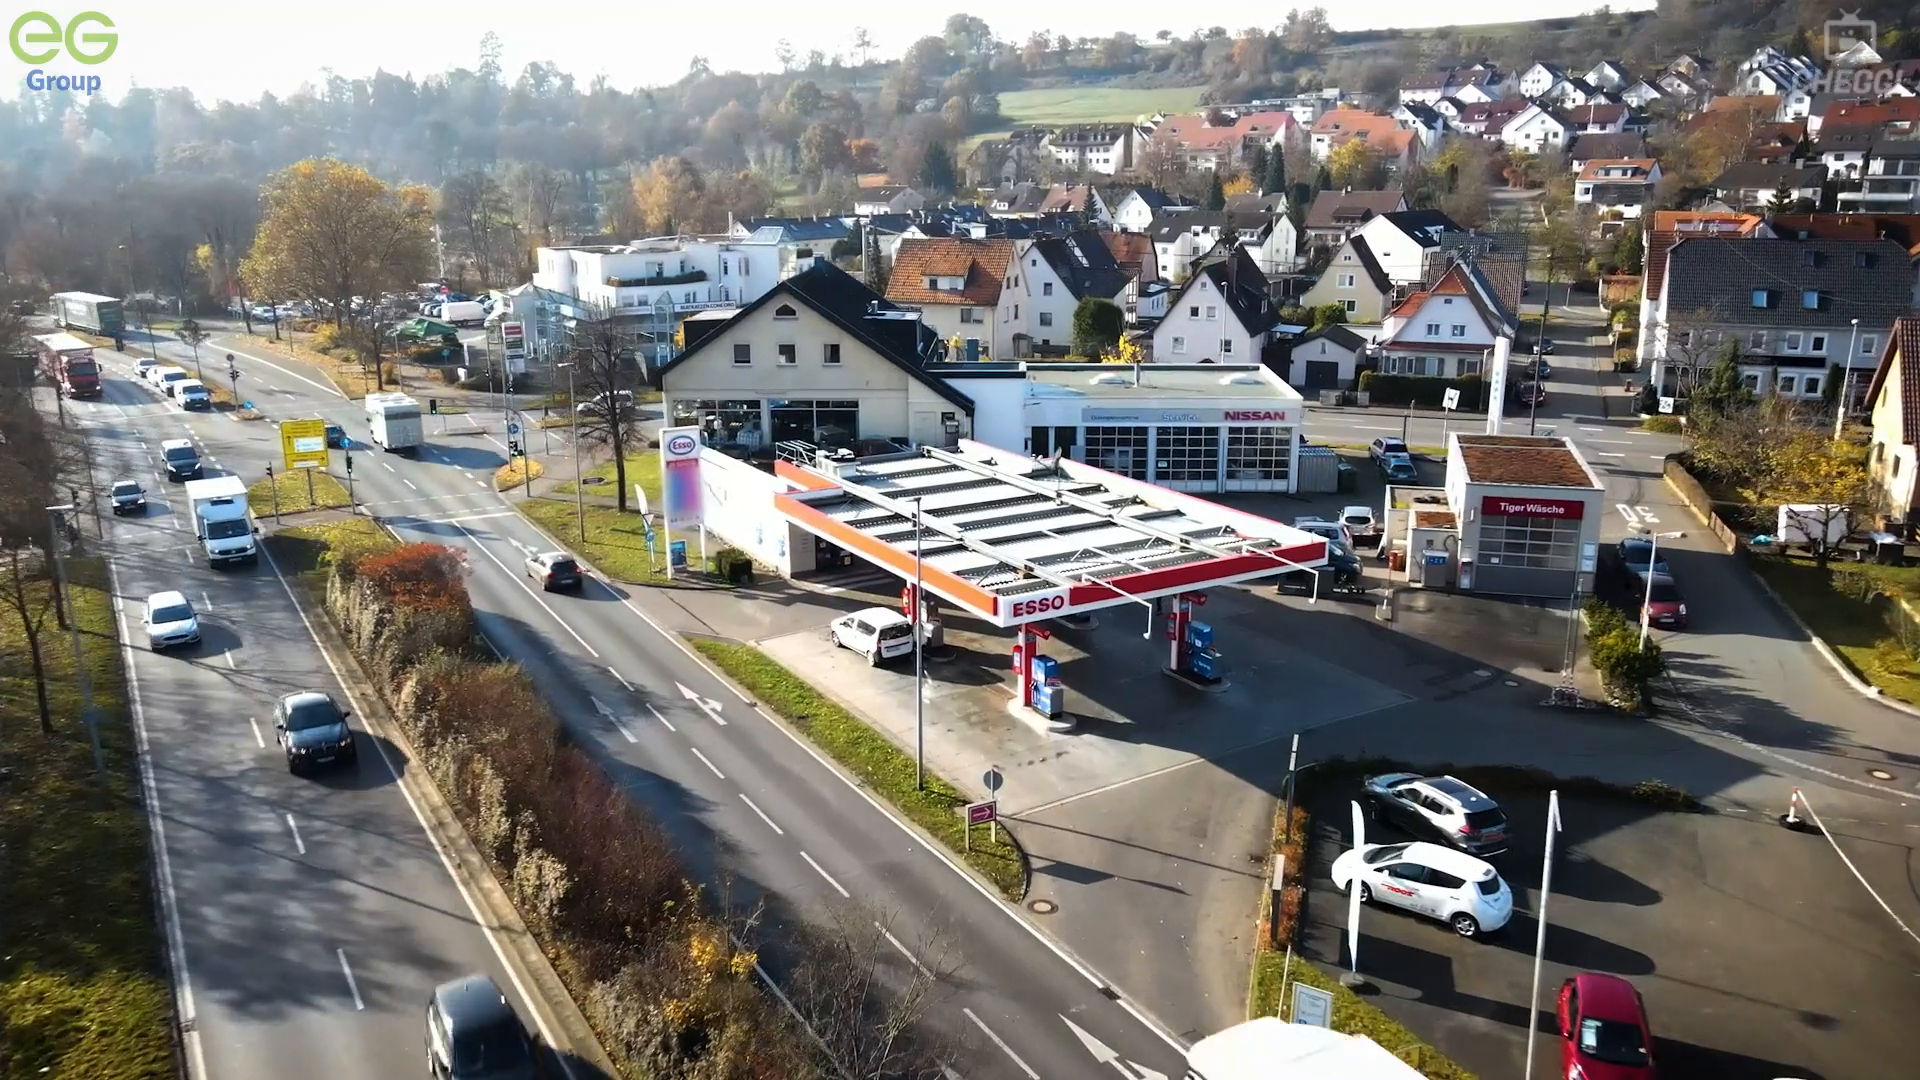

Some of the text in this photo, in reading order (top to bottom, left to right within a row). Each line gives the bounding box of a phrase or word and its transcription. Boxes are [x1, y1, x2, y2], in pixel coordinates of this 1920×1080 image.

[1224, 411, 1286, 420] NISSAN
[672, 441, 692, 450] Esso
[1500, 502, 1565, 514] Tiger Wäsche
[1012, 595, 1065, 618] ESSO
